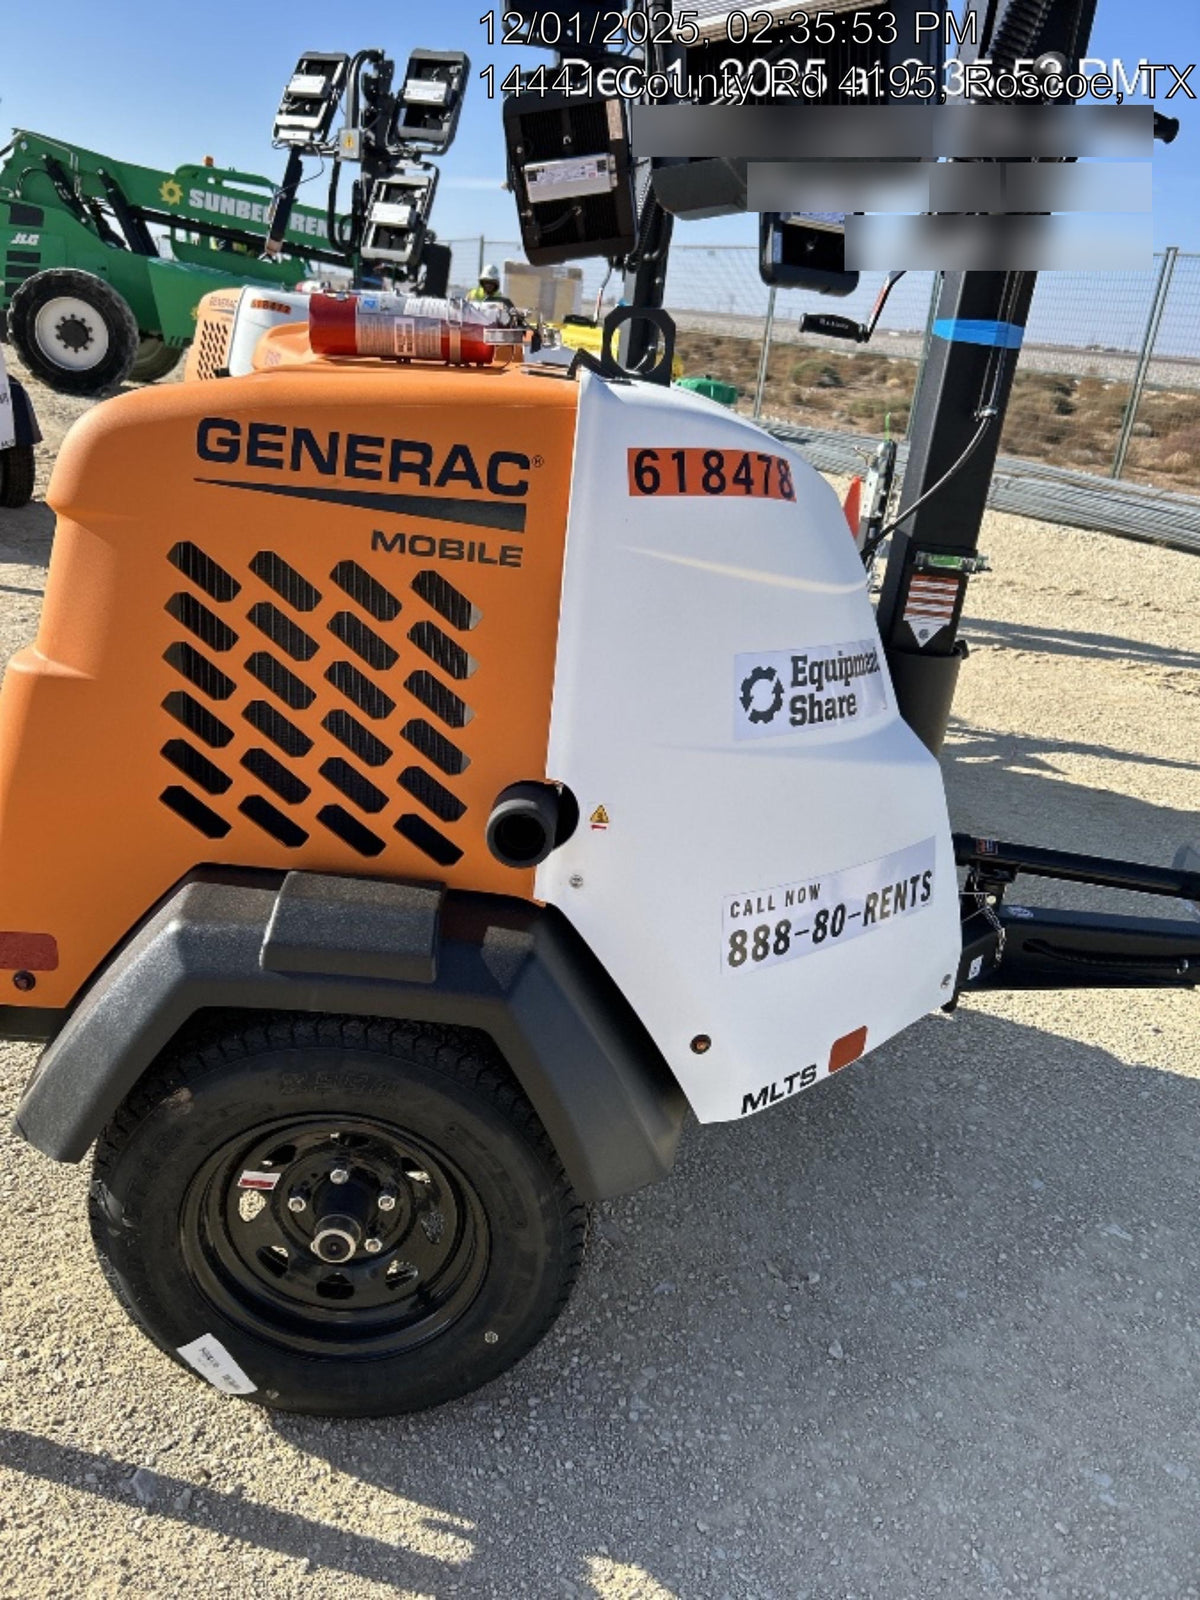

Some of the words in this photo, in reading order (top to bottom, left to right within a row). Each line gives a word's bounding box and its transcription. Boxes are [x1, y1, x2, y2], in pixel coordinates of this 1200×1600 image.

[634, 449, 795, 501] 618478
[371, 529, 524, 568] MOBILE
[789, 693, 858, 728] Share
[727, 870, 933, 968] 888-80-RENTS
[730, 894, 776, 919] CALL
[785, 883, 822, 908] NOW
[741, 1063, 817, 1115] MLTS
